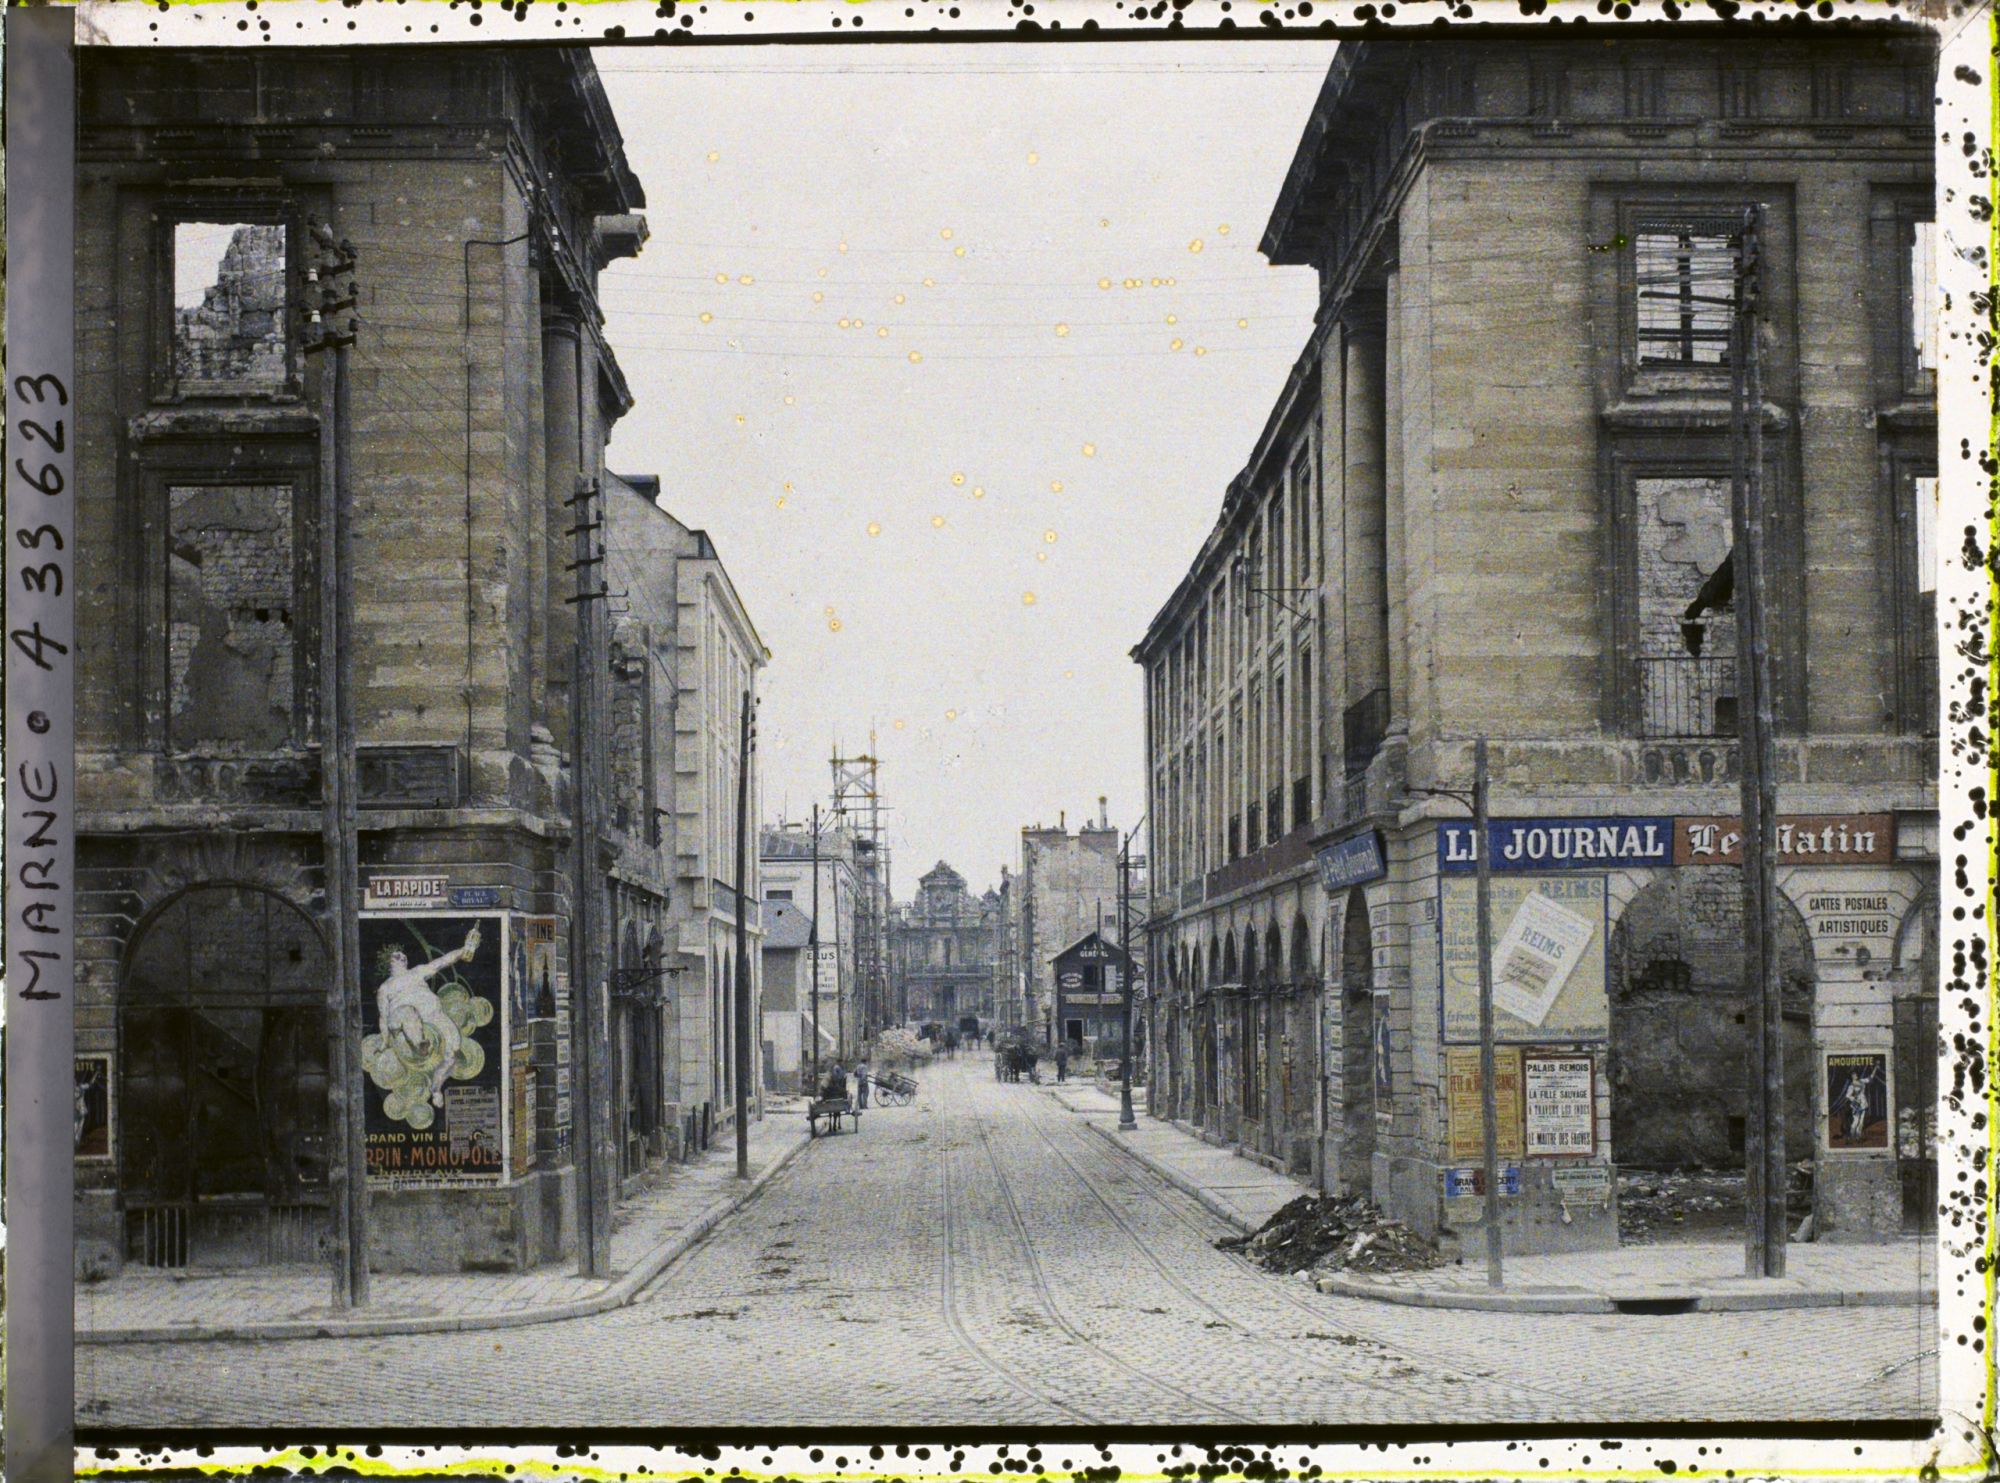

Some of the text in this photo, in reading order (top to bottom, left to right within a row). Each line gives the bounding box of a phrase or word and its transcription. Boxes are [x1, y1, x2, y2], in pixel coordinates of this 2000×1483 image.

[1503, 825, 1664, 860] JOURNAL
[1688, 824, 1740, 856] Le
[19, 759, 61, 1001] MARNE
[1539, 880, 1601, 899] REIMS
[1845, 897, 1888, 910] POSTALES
[1819, 920, 1888, 934] ARTISTIQUES
[1520, 925, 1566, 960] REIMS
[1527, 1063, 1556, 1073] PALAIS
[1559, 1063, 1589, 1073] REMOIS
[1829, 1056, 1875, 1067] AMOURETTE
[1529, 1090, 1587, 1099] LA FILLE SAUVAGE
[366, 1133, 406, 1143] RAND
[411, 1133, 433, 1142] VIN
[1528, 1132, 1535, 1146] LE
[1559, 1132, 1569, 1146] DES
[366, 1147, 402, 1168] RPIN
[1454, 1178, 1479, 1187] GRAND
